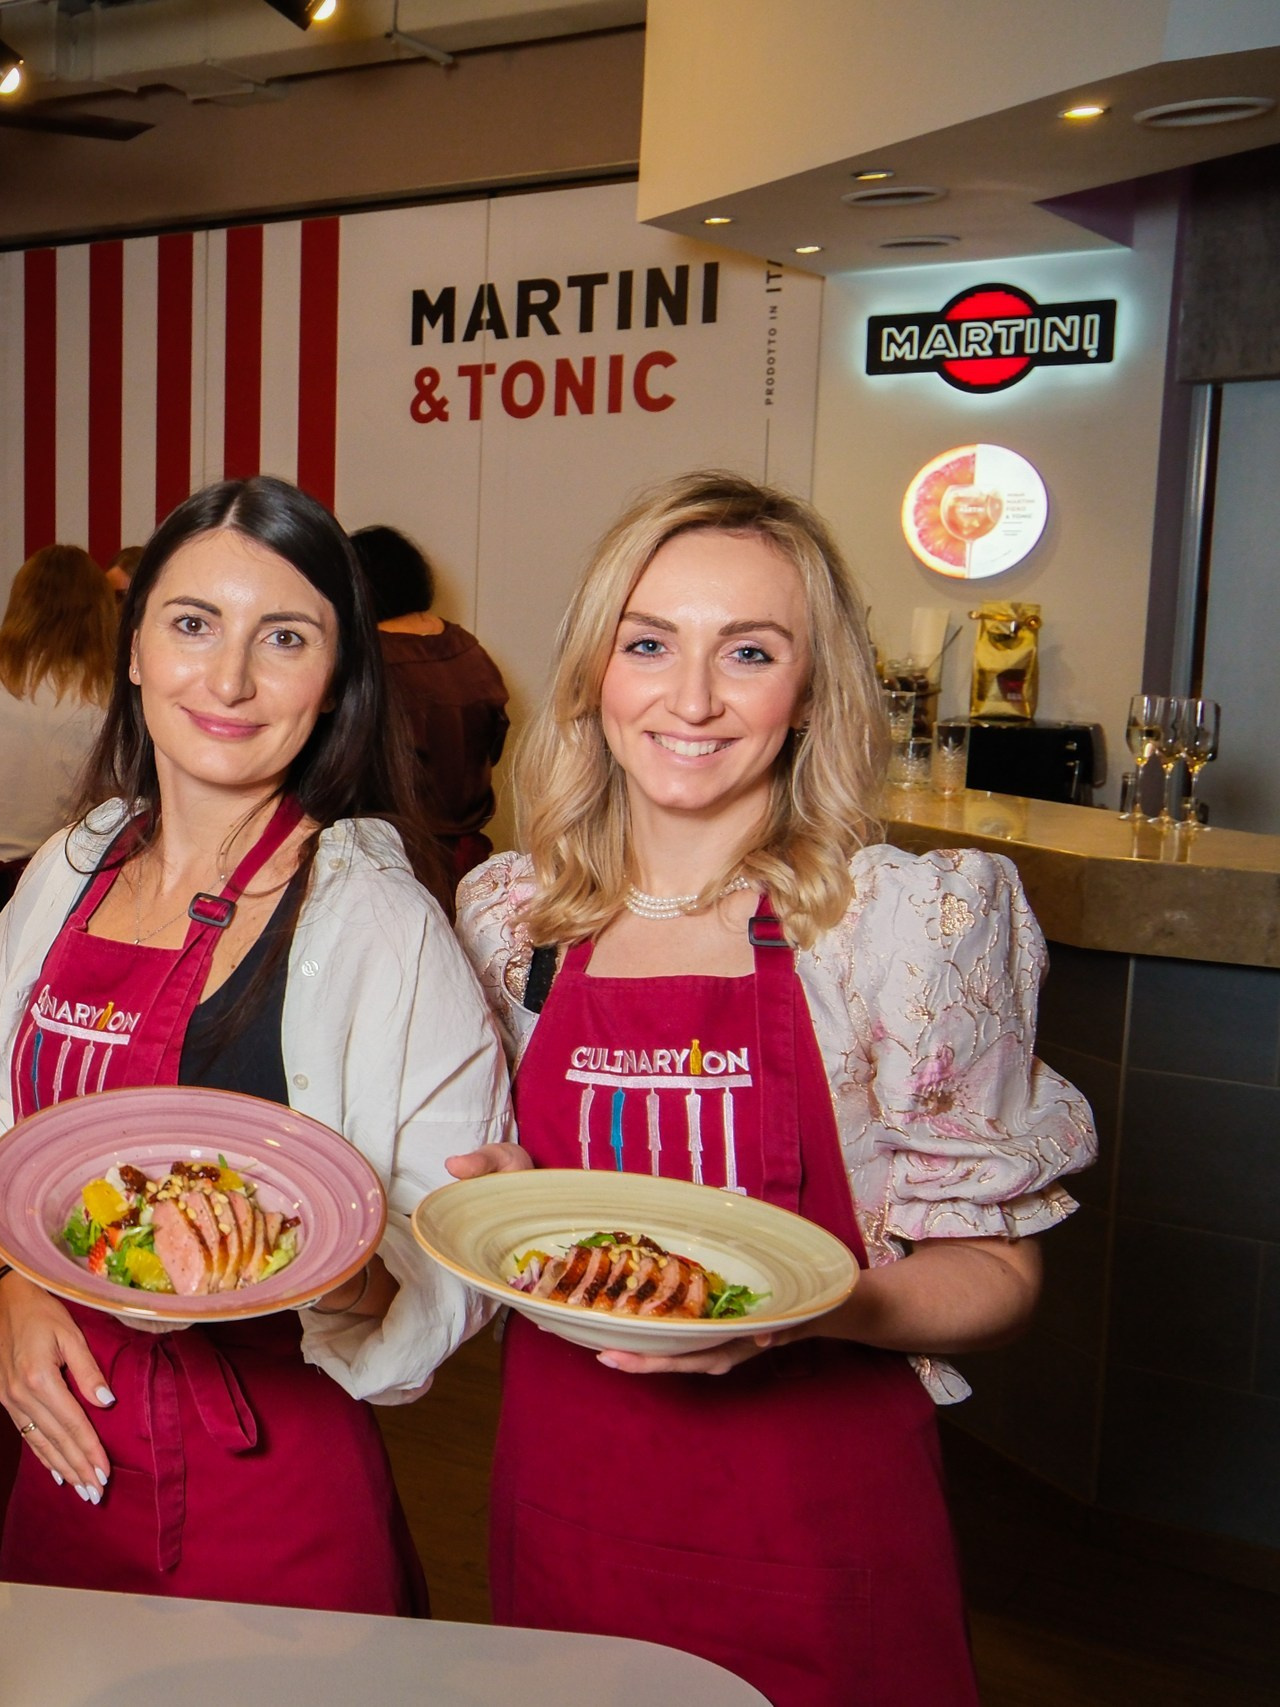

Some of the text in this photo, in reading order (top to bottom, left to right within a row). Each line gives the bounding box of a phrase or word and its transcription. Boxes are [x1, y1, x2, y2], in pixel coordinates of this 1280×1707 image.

[410, 261, 720, 346] MARTINI
[769, 305, 779, 320] IN
[765, 327, 778, 406] PRODOTTO
[880, 313, 1101, 362] MARTINI
